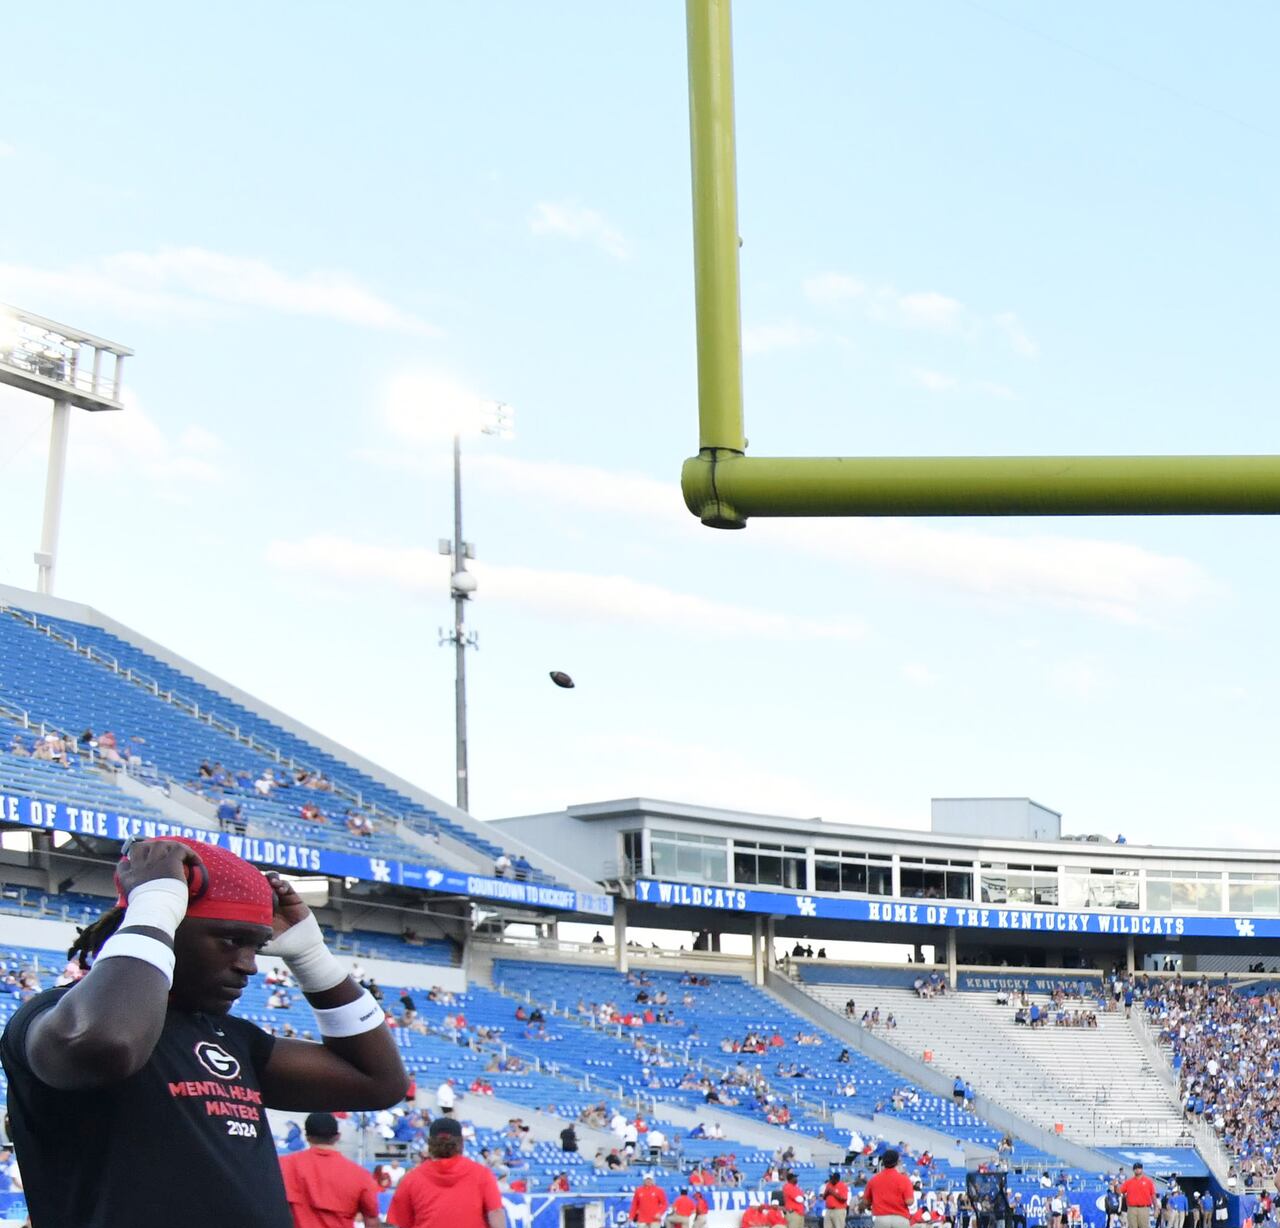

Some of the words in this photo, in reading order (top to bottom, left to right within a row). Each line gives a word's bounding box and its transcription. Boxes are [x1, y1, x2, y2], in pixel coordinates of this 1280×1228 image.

[31, 801, 56, 827] OF
[66, 807, 107, 836] THE
[228, 836, 321, 870] WILDCATS
[468, 877, 524, 899] COUNTDOWN
[527, 885, 537, 900] TO
[538, 887, 575, 908] KICKOFF
[658, 884, 746, 909] WILDCATS
[868, 902, 918, 924] HOME
[927, 906, 948, 925] OF
[956, 908, 990, 928] THE
[998, 910, 1090, 932] KENTUCKY
[1098, 916, 1184, 935] WILDCATS
[966, 978, 1029, 991] KENTUCKY
[169, 1081, 229, 1098] MENTAL
[226, 1120, 258, 1138] 2024
